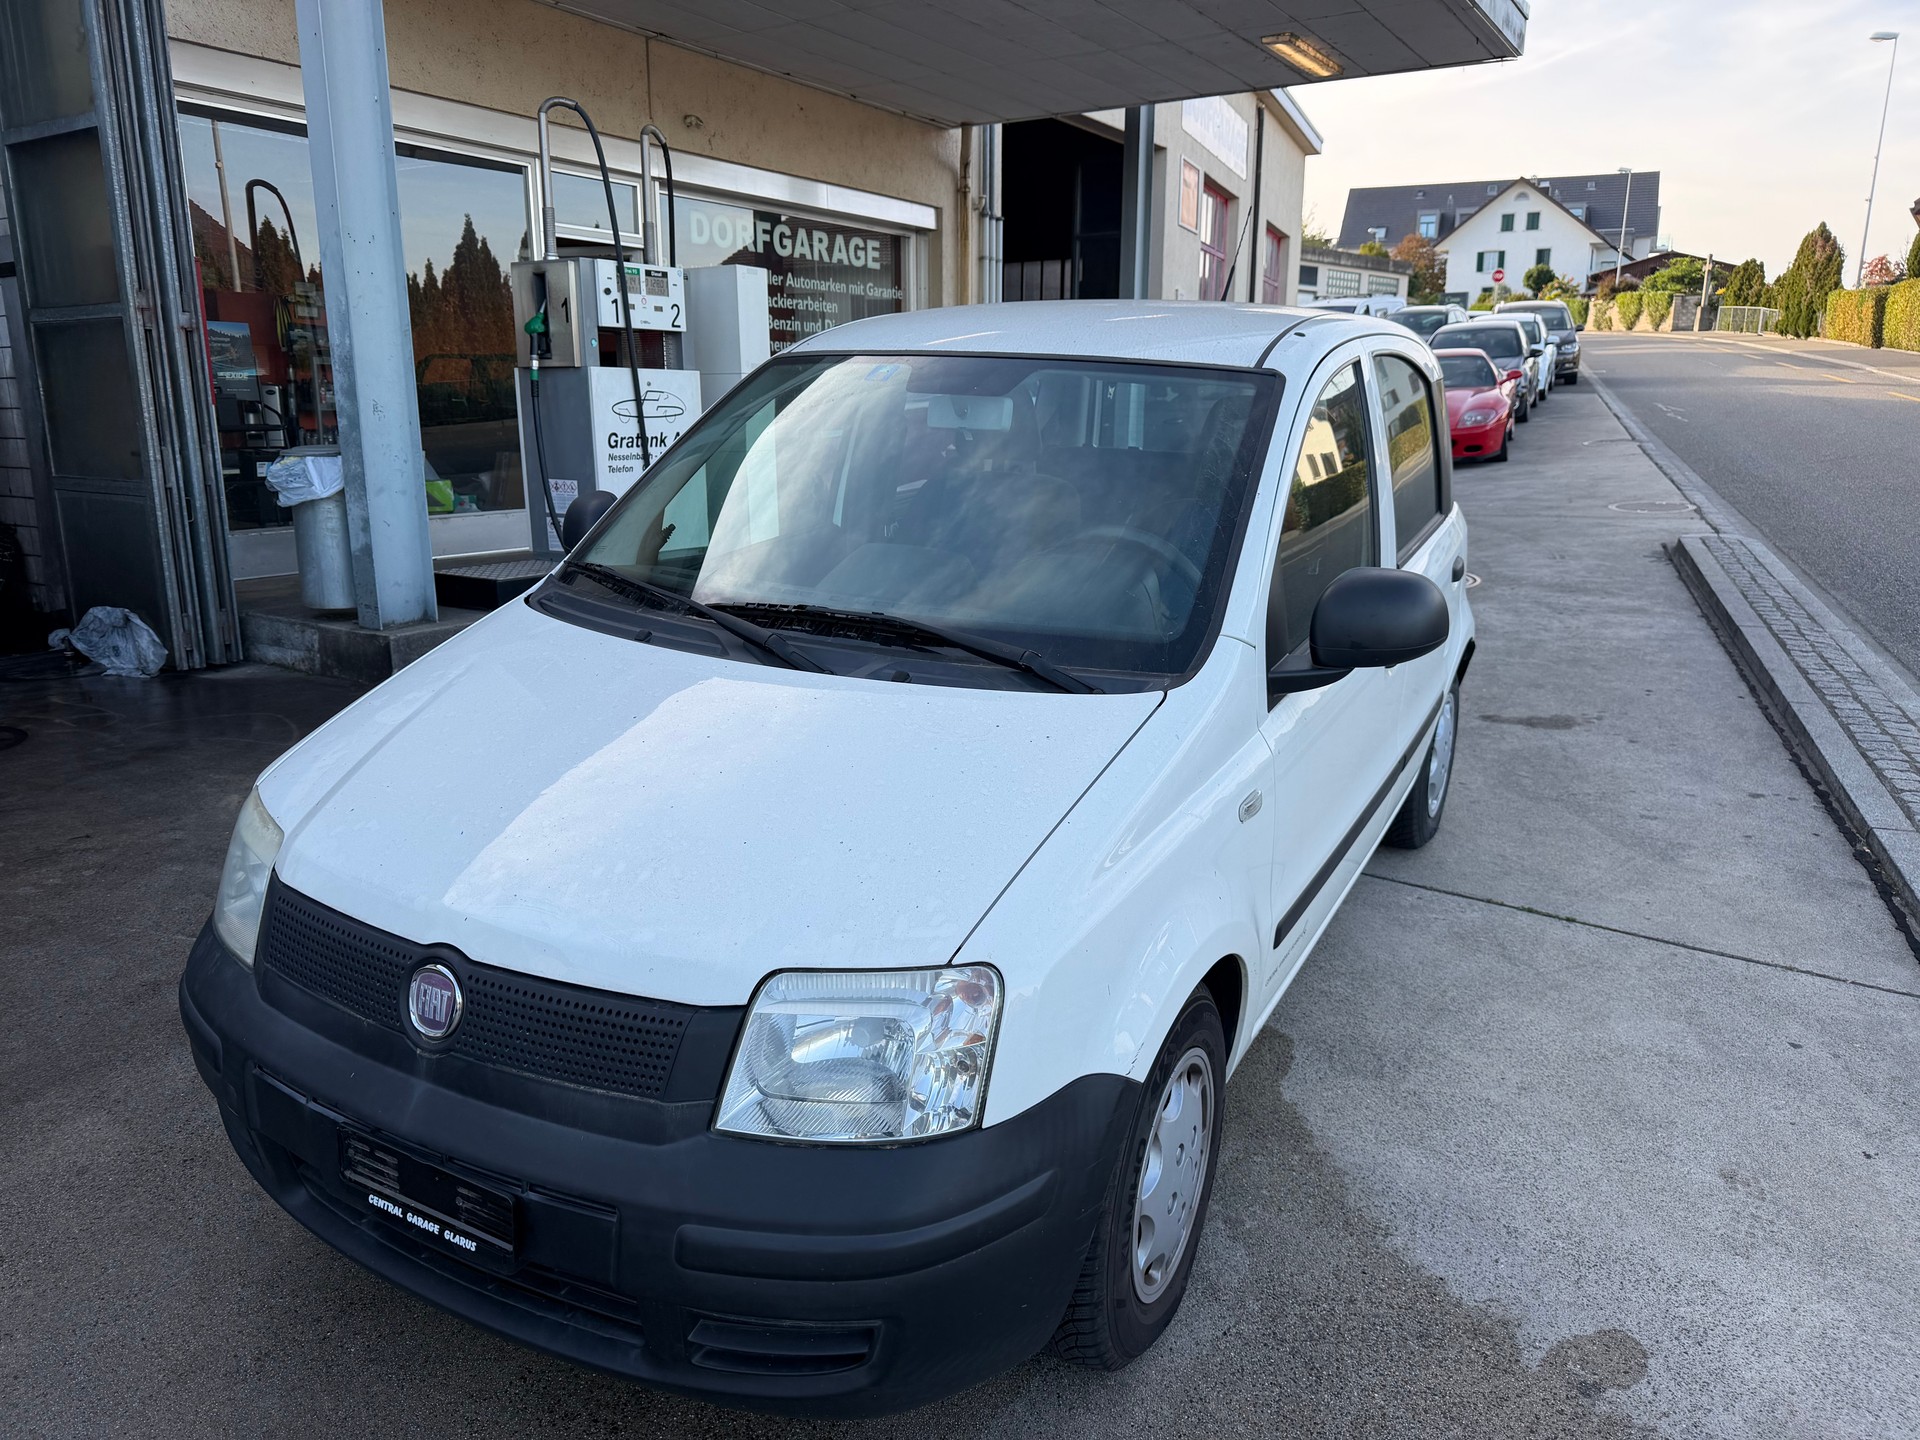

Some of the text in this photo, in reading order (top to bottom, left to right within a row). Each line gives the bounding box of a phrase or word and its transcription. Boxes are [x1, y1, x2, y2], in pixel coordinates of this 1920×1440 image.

[689, 210, 881, 270] DORFGARAGE
[786, 271, 846, 293] Automarken
[849, 281, 864, 295] mit
[866, 283, 903, 299] Garantie
[560, 297, 569, 324] 1
[611, 298, 619, 324] 1
[670, 303, 681, 328] 2
[768, 293, 838, 313] ackierarbeiten
[804, 319, 821, 332] und
[608, 432, 667, 449] Gratnk
[608, 465, 634, 473] Telefon
[418, 983, 451, 1023] FIAT
[368, 1194, 477, 1252] CENTRAL GARAGE GLARUS
